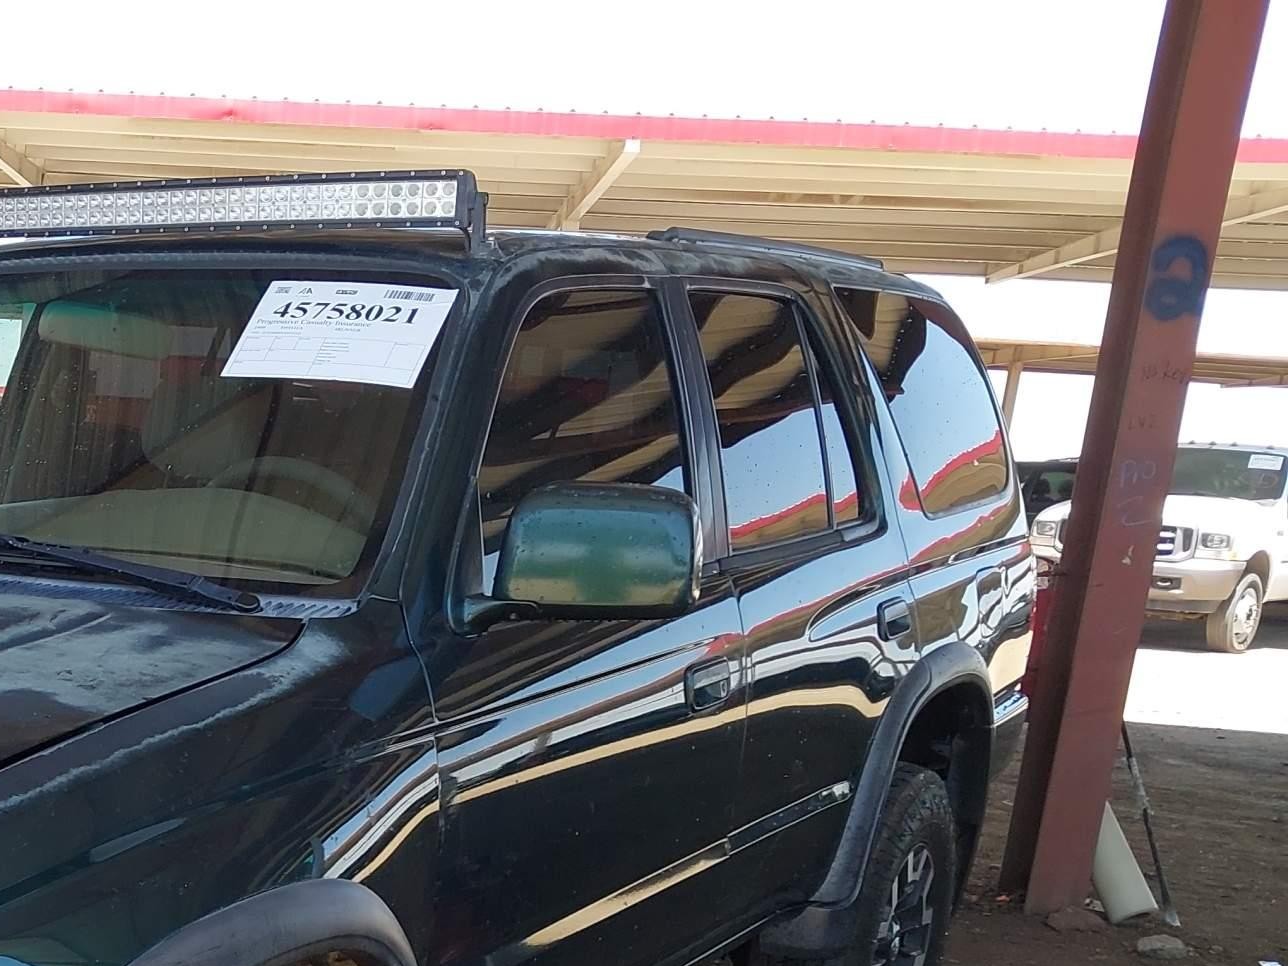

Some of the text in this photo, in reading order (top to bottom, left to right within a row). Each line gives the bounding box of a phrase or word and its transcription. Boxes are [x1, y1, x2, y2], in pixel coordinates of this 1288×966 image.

[272, 301, 420, 324] 45758021
[300, 319, 333, 327] Casualty
[334, 320, 372, 328] Insurance
